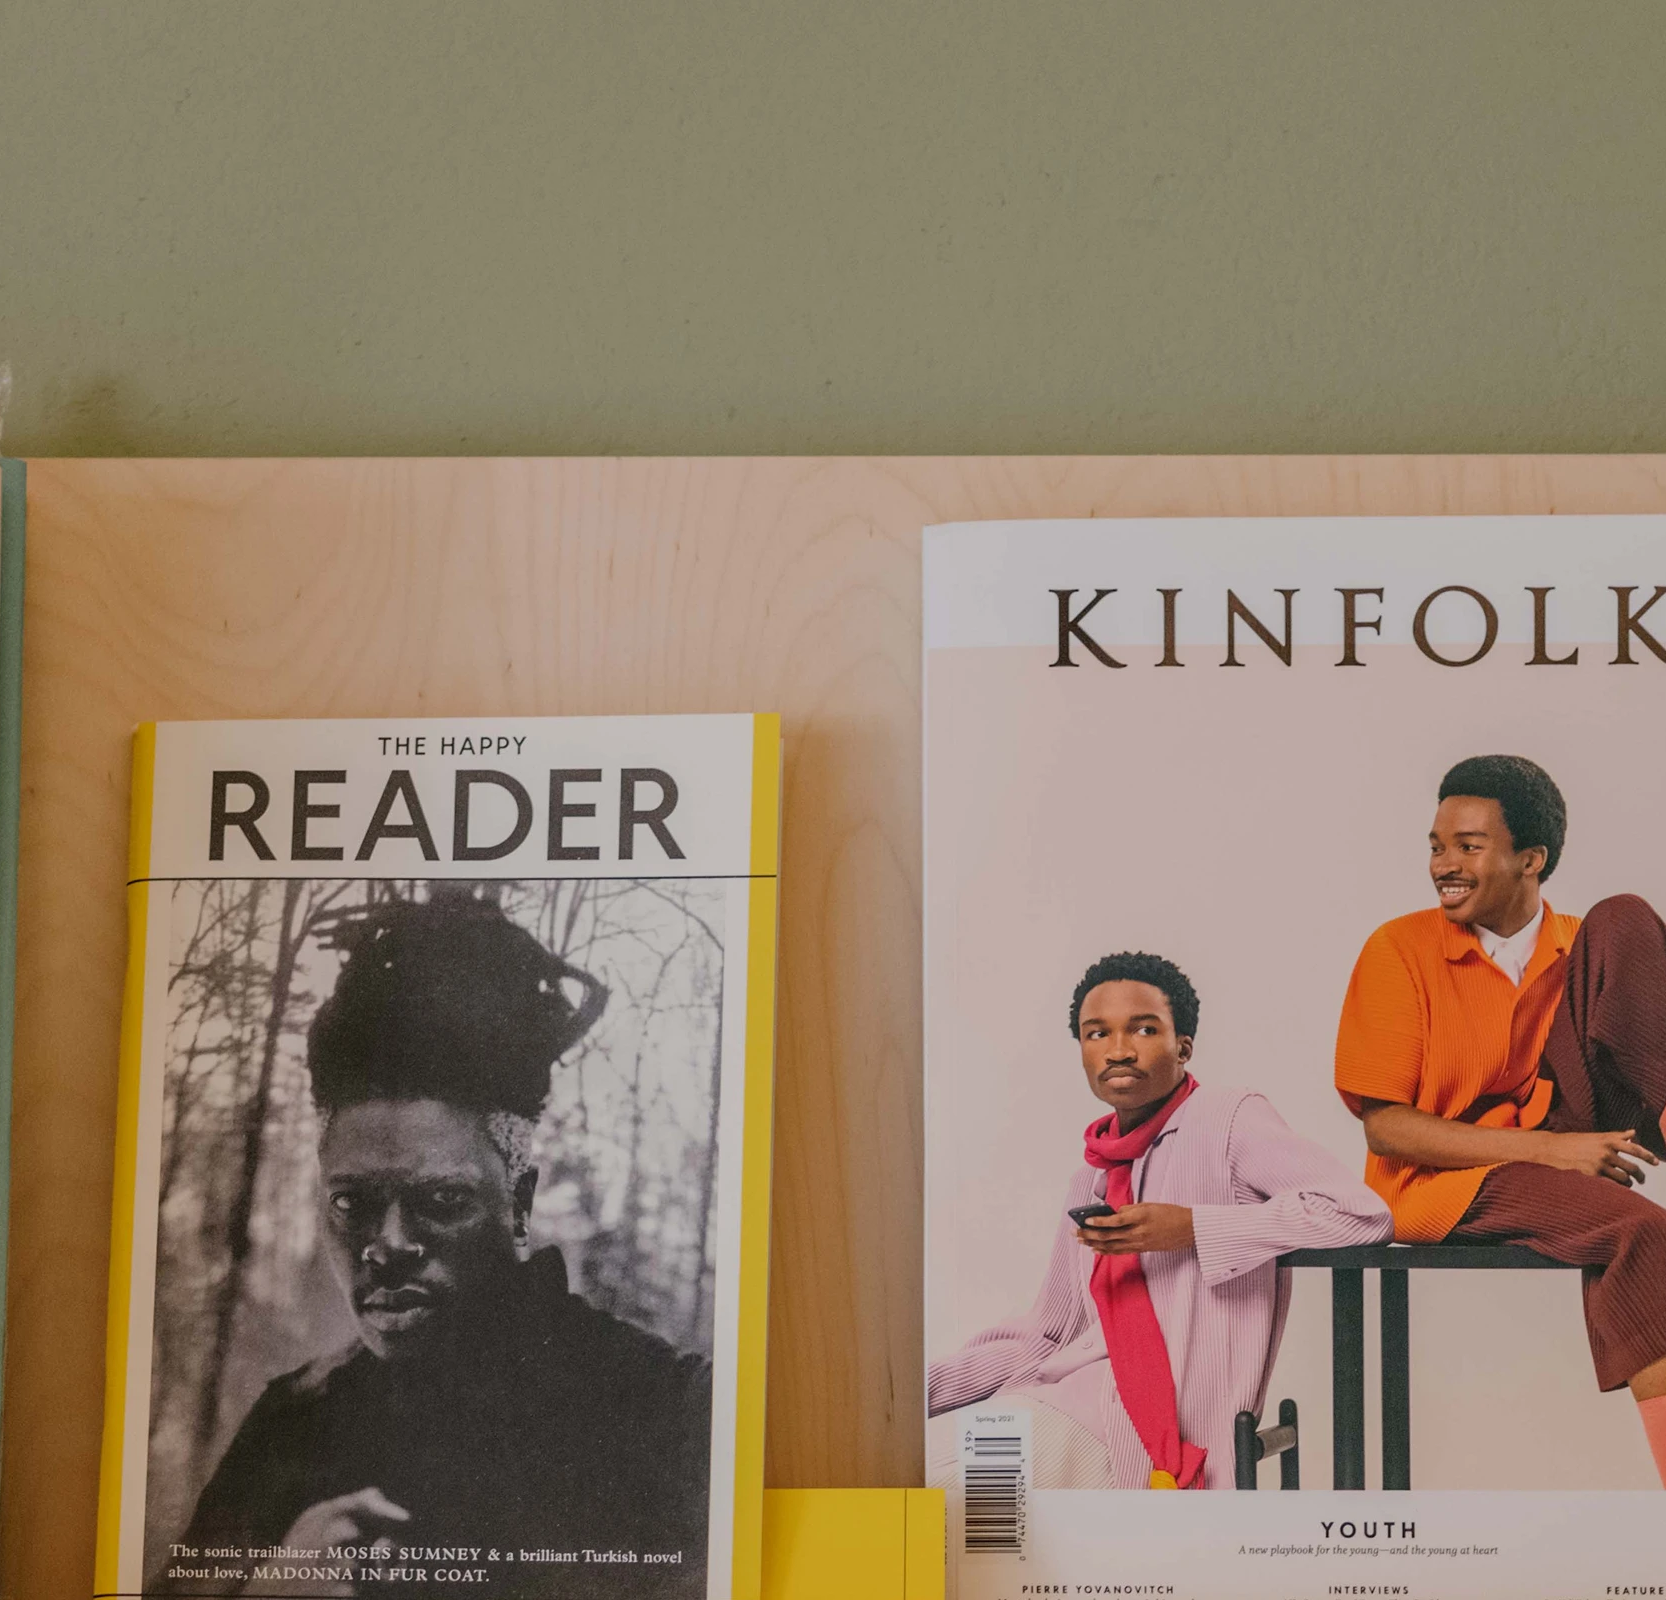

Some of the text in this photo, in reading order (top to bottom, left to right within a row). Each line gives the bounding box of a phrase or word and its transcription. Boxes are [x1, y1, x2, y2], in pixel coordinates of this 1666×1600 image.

[377, 735, 527, 756] THE HAPPY
[208, 767, 687, 862] READER
[975, 1415, 1016, 1424] Spring 2021
[1320, 1521, 1416, 1539] YOUTH
[169, 1543, 683, 1564] The sonic trailblazer MOSES SUMNEY & a brilliant Turkish novel
[1237, 1545, 1247, 1555] A
[1248, 1547, 1268, 1555] new
[1270, 1545, 1314, 1557] playbook
[1314, 1545, 1331, 1557] for
[1332, 1545, 1348, 1555] the
[1410, 1545, 1427, 1555] the
[1427, 1547, 1458, 1557] young
[1459, 1546, 1471, 1555] at
[1472, 1545, 1499, 1555] heart
[167, 1566, 490, 1582] about love, MADONNA IN FUR COAT.
[1022, 1585, 1174, 1595] PIERRE YOVANOVITCH
[1328, 1585, 1409, 1595] INTERVIEWS
